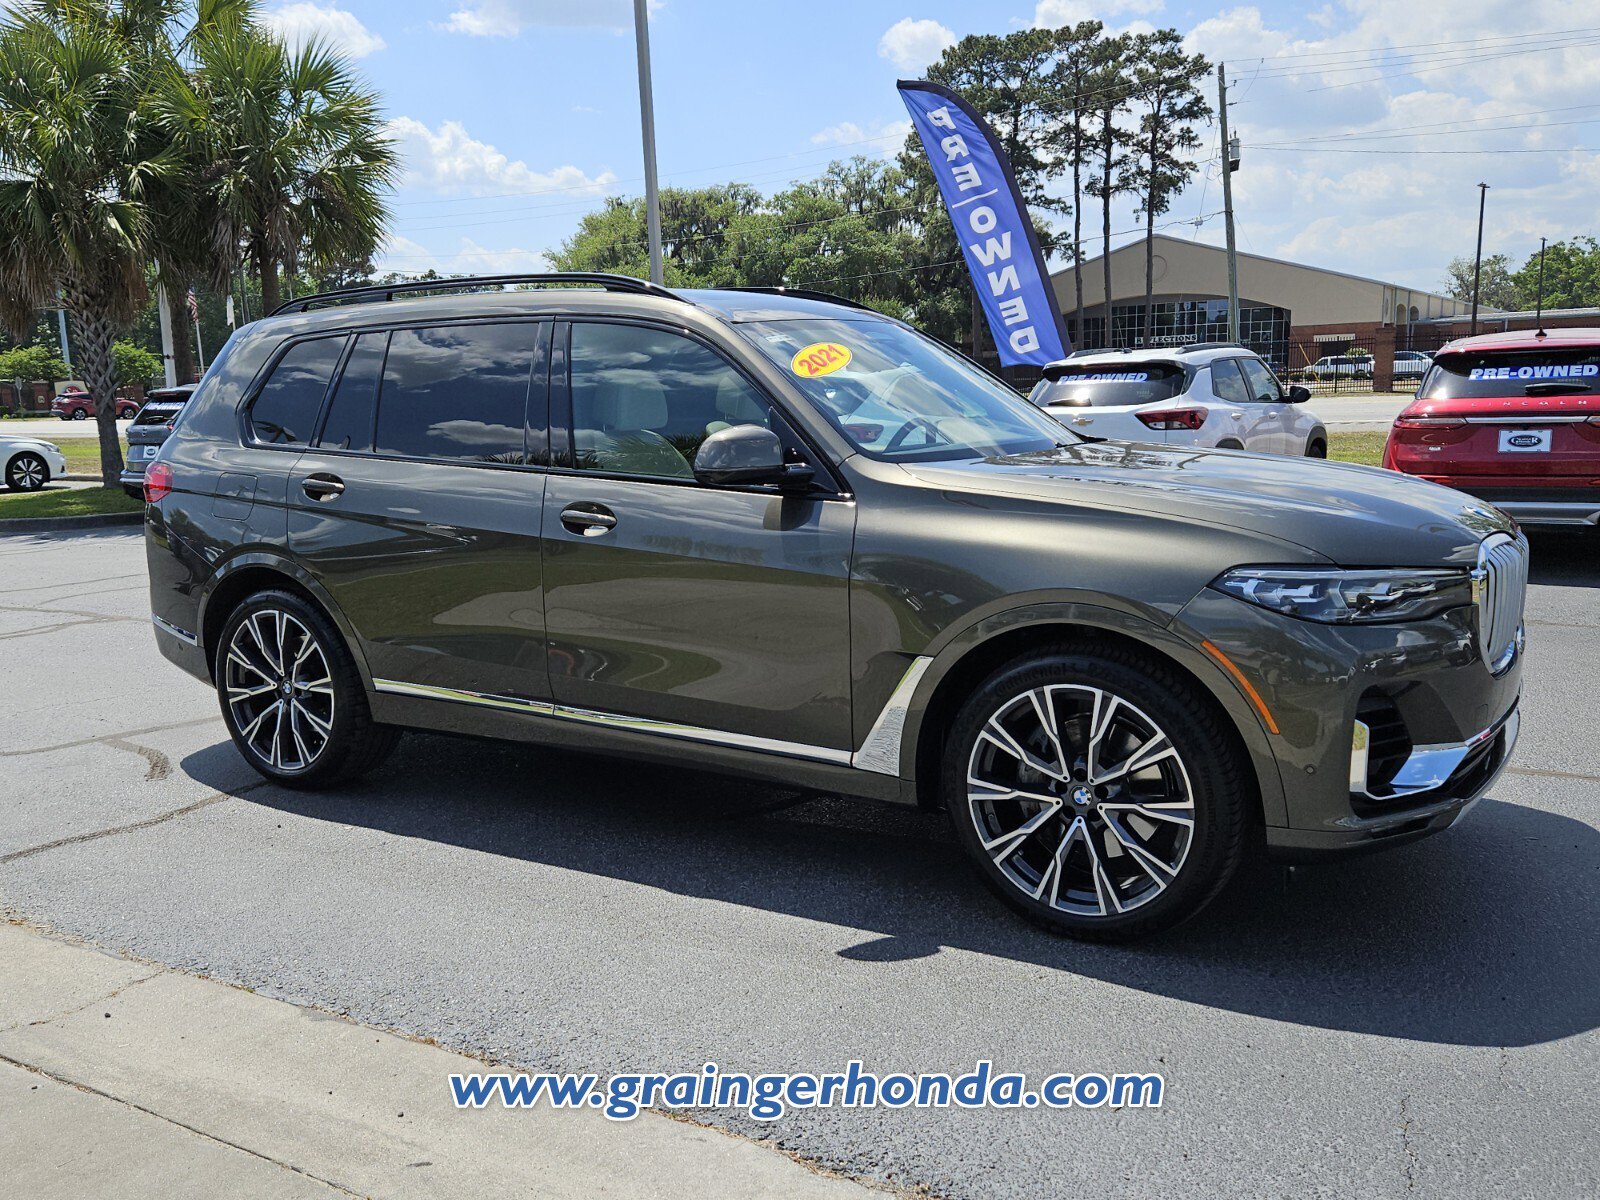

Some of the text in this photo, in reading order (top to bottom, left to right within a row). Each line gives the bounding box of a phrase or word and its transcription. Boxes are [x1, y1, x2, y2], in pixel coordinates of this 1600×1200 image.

[1136, 334, 1197, 345] RLECTIONS
[798, 344, 846, 375] 2021
[1057, 372, 1148, 385] PRE-OWNED
[1468, 364, 1599, 380] PRE-OWNED
